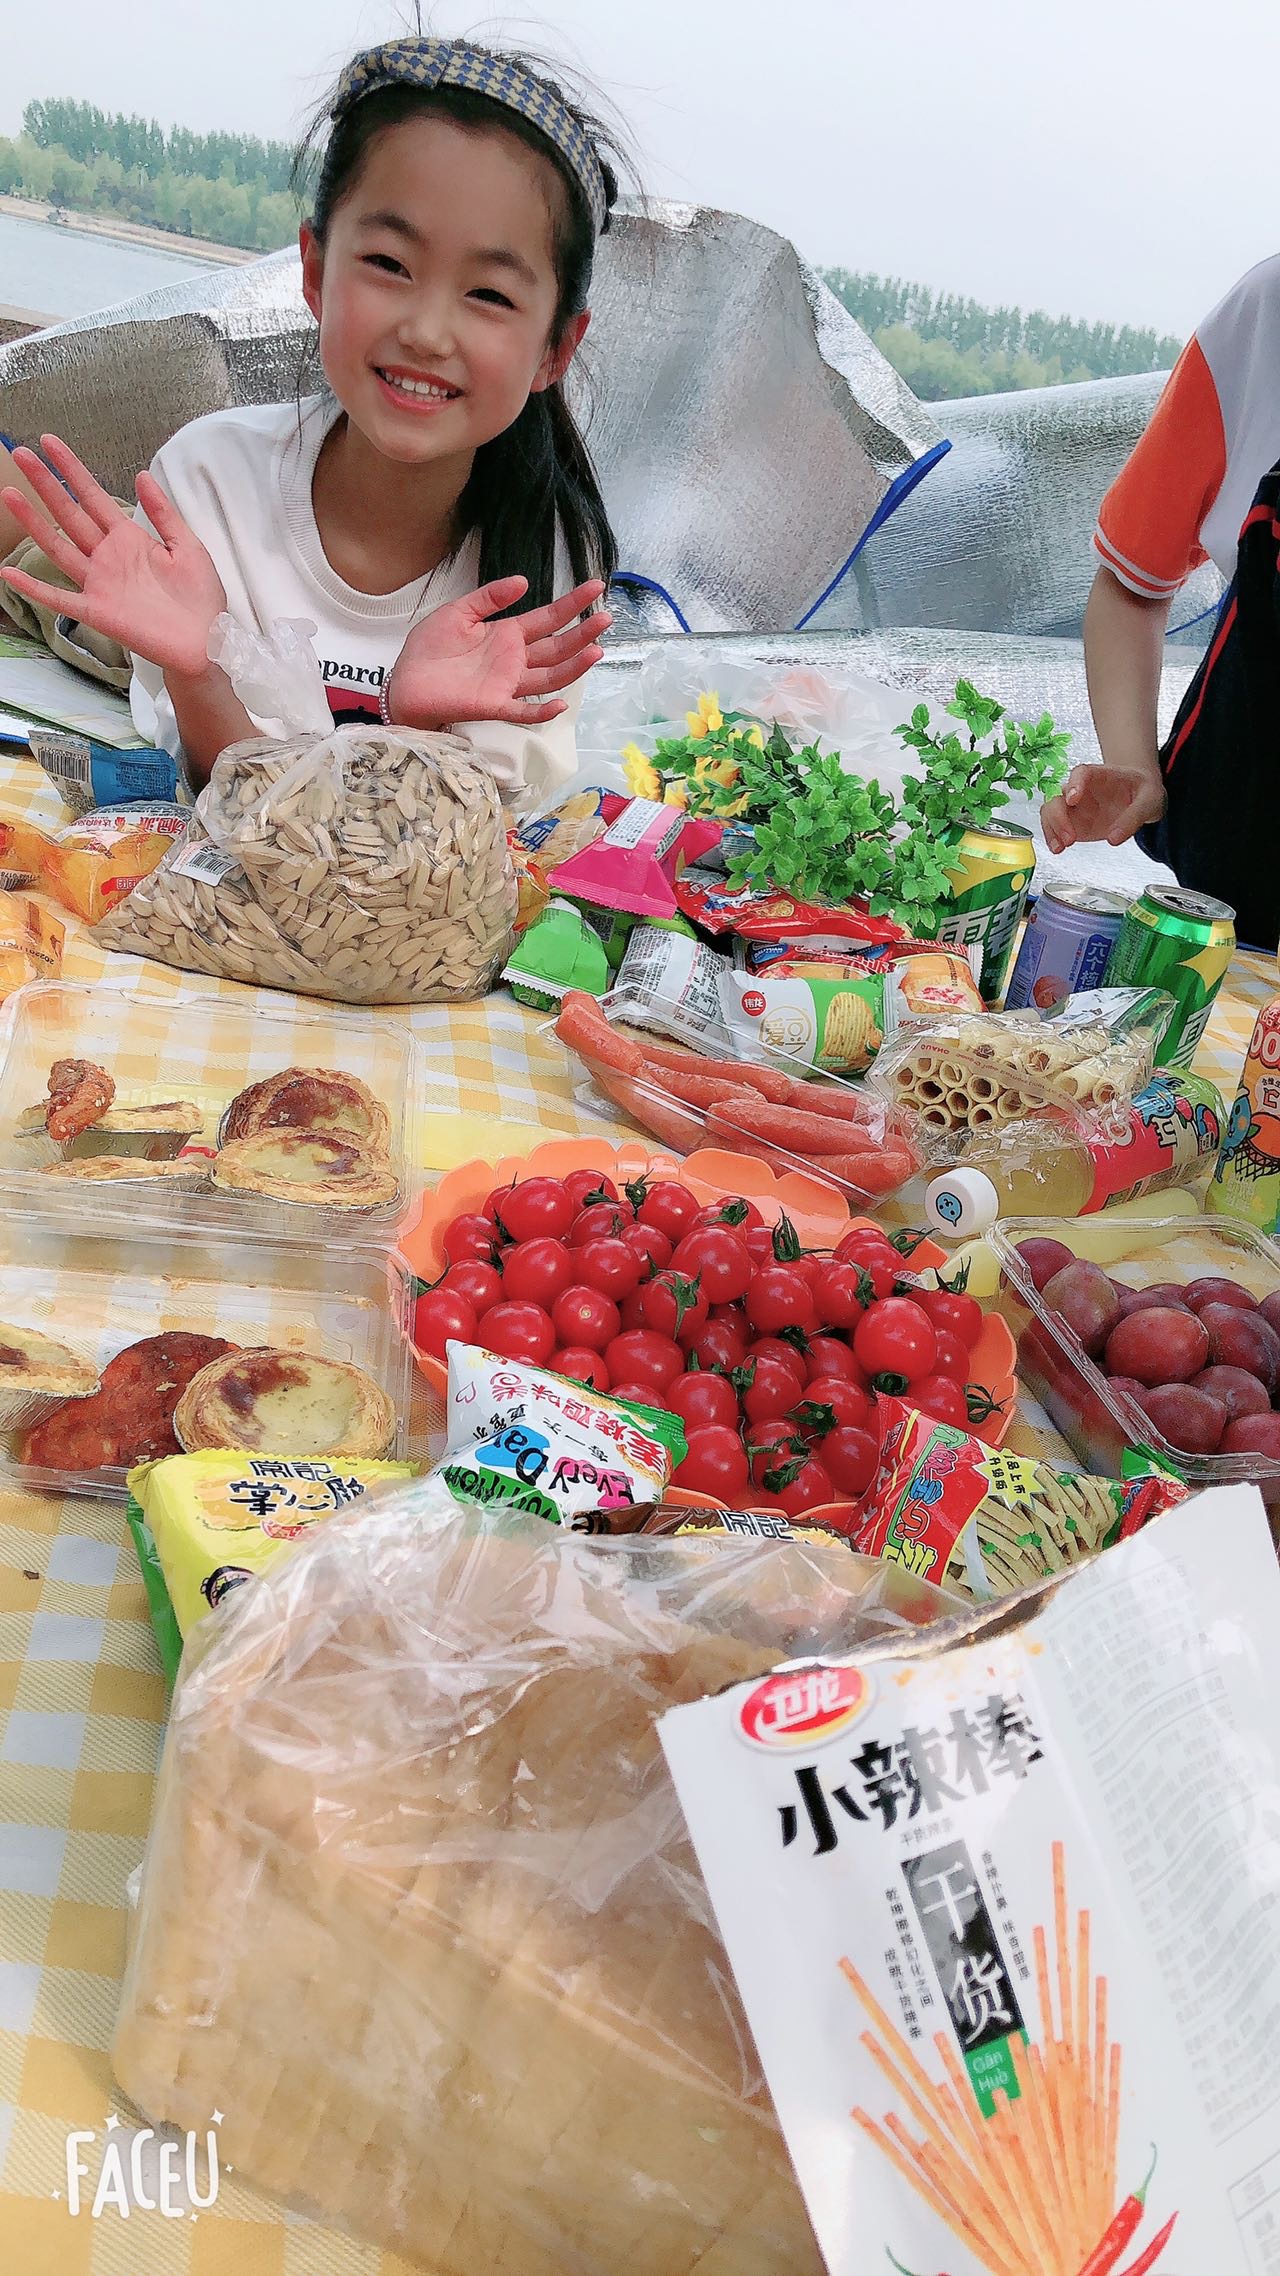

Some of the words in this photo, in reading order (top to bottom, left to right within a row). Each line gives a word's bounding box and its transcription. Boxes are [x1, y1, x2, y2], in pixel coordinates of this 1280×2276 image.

[318, 660, 385, 687] pard
[1077, 941, 1108, 992] 六个核
[764, 1671, 856, 1727] 卫龙
[776, 1693, 1045, 1856] 小辣棒
[918, 1860, 1011, 2045] 干货
